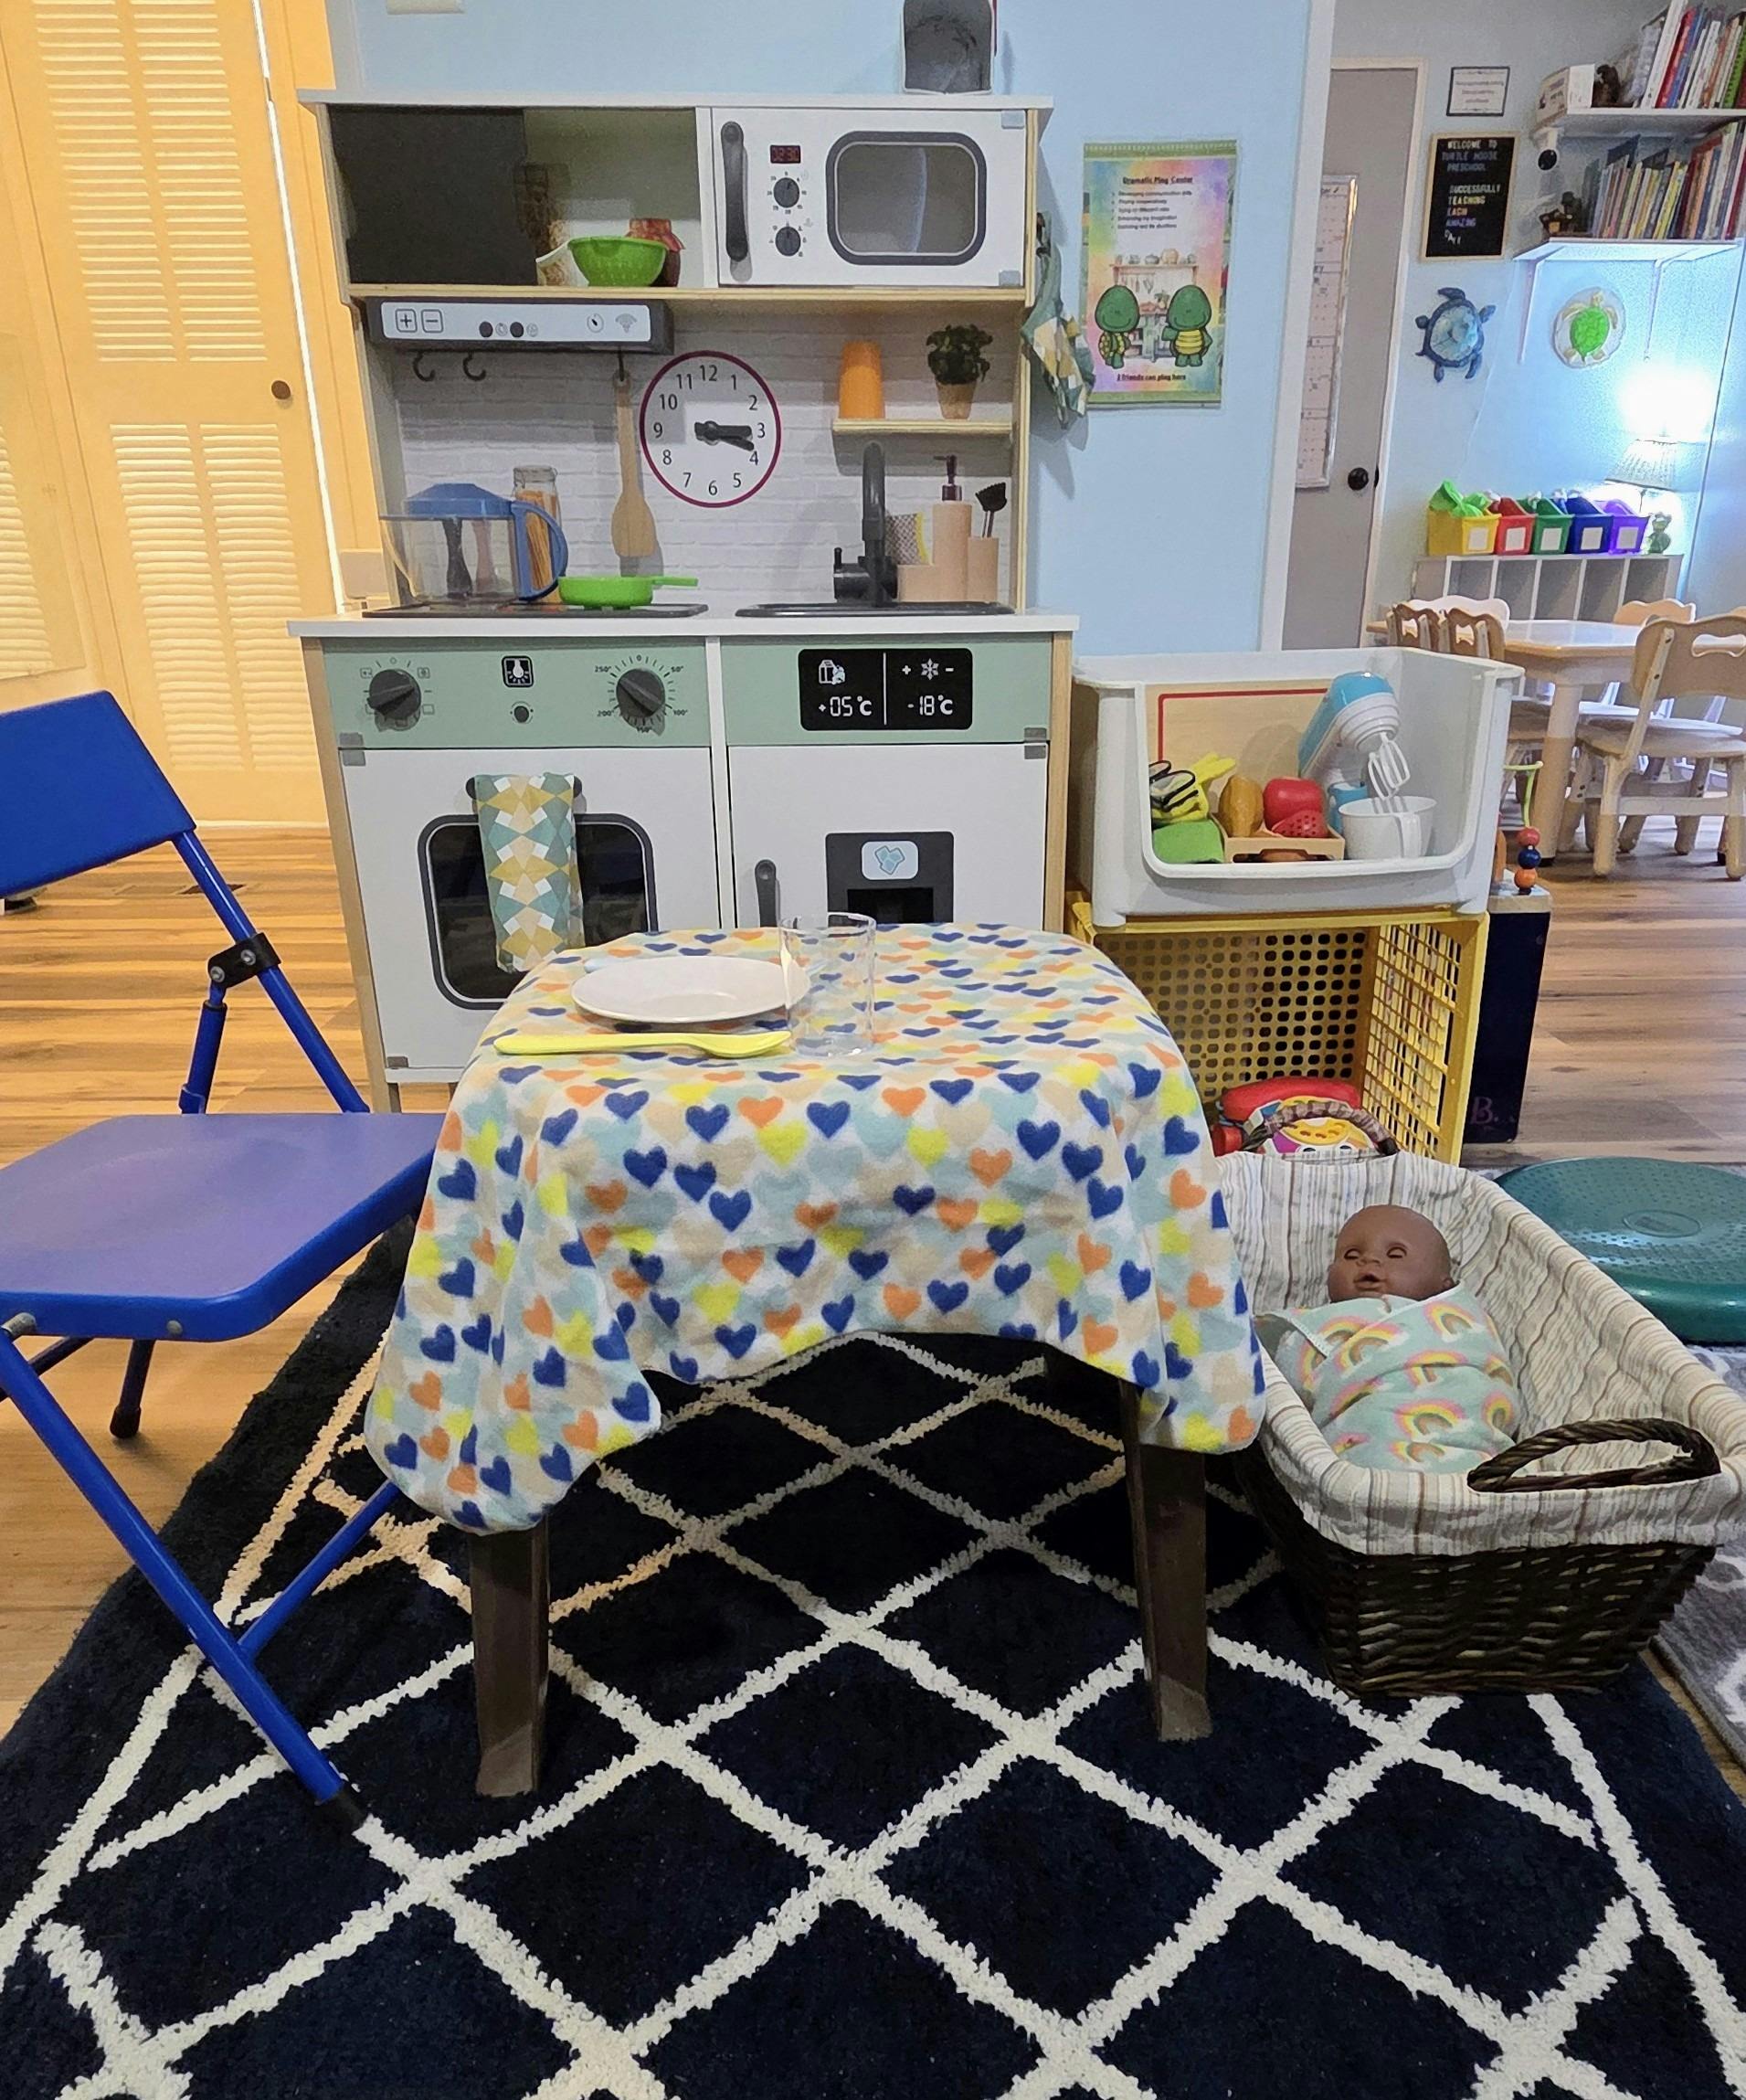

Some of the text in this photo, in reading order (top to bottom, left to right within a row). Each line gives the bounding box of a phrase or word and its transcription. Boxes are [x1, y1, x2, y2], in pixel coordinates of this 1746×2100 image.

[1447, 140, 1481, 149] WELCOME
[1123, 176, 1193, 185] Dramatic Play Center
[676, 373, 693, 389] 11
[700, 365, 717, 382] 12
[1157, 373, 1171, 382] play
[731, 375, 737, 390] 1
[660, 394, 678, 410] 10
[748, 395, 758, 410] 2
[653, 422, 663, 439] 9
[757, 422, 766, 439] 3
[662, 449, 672, 465] 8
[749, 451, 759, 466] 4
[683, 472, 692, 488] 7
[708, 480, 718, 495] 6
[733, 472, 742, 488] 5
